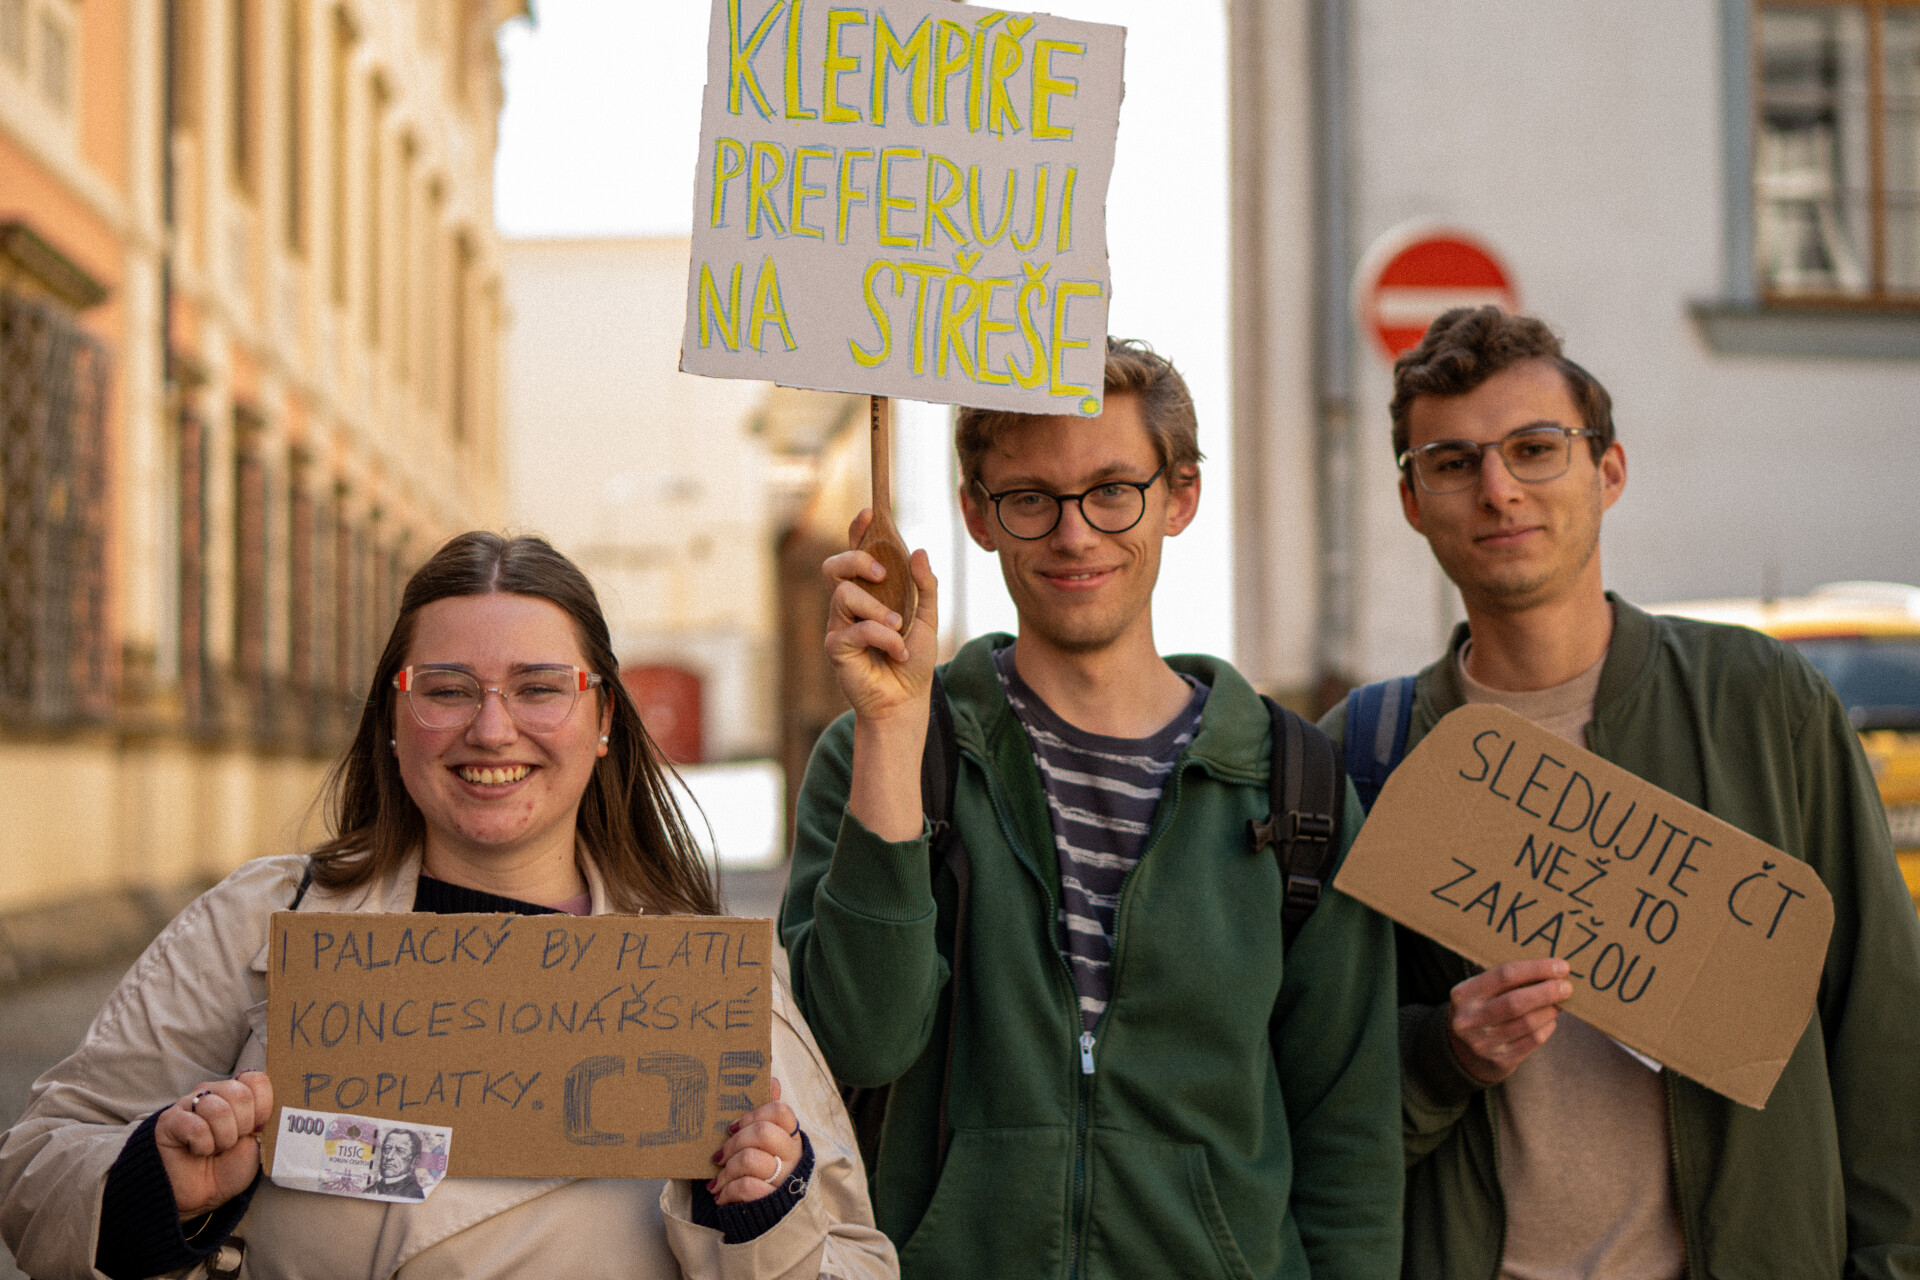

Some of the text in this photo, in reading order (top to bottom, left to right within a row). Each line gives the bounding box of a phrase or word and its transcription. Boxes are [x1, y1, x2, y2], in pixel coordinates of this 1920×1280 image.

[726, 0, 1087, 142] KLEMPÍŘE
[710, 136, 1078, 254] PREFERUJI
[699, 248, 1104, 416] NA STŘEŠE.
[1459, 729, 1806, 939] SLEDUJTE ČT
[1514, 833, 1680, 944] NEŽ TO
[313, 916, 515, 972] PALACKÝ
[540, 928, 596, 971] BY
[616, 931, 762, 975] PLATIL
[288, 979, 760, 1050] KONCESIONÁŘSKÉ
[287, 1114, 325, 1136] 1000
[302, 1069, 545, 1111] POPLATKY.
